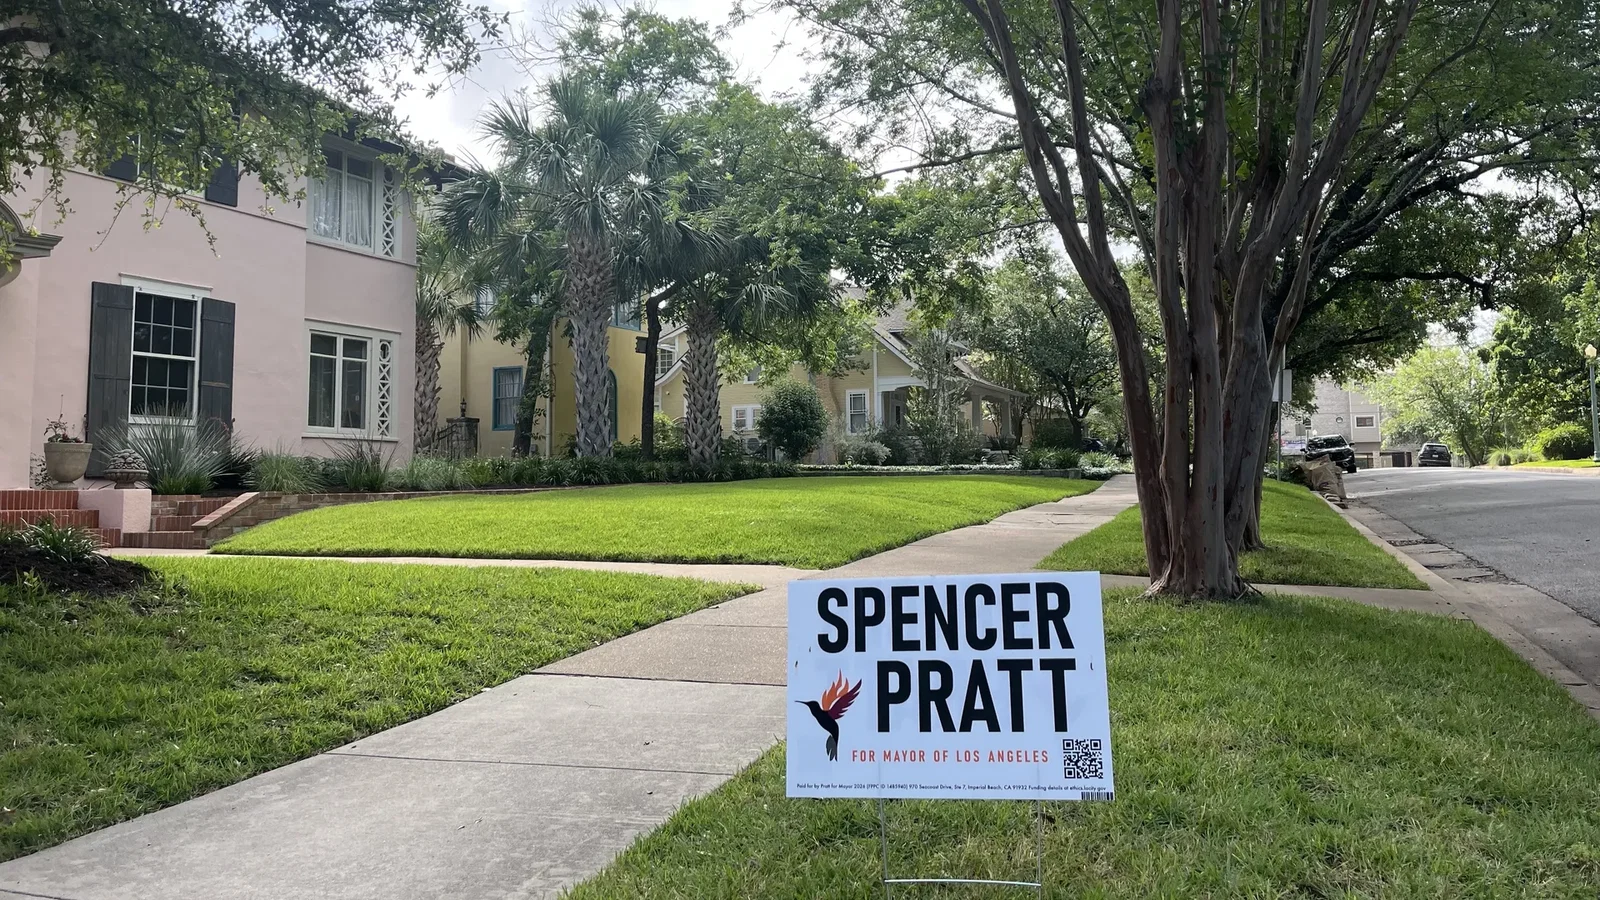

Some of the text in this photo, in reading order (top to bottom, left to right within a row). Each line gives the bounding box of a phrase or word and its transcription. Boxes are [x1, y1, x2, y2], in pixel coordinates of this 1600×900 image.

[817, 582, 1075, 653] SPENCER
[877, 658, 1076, 732] PRATT
[852, 750, 1049, 763] FOR MAYOR OF LOS ANGELES
